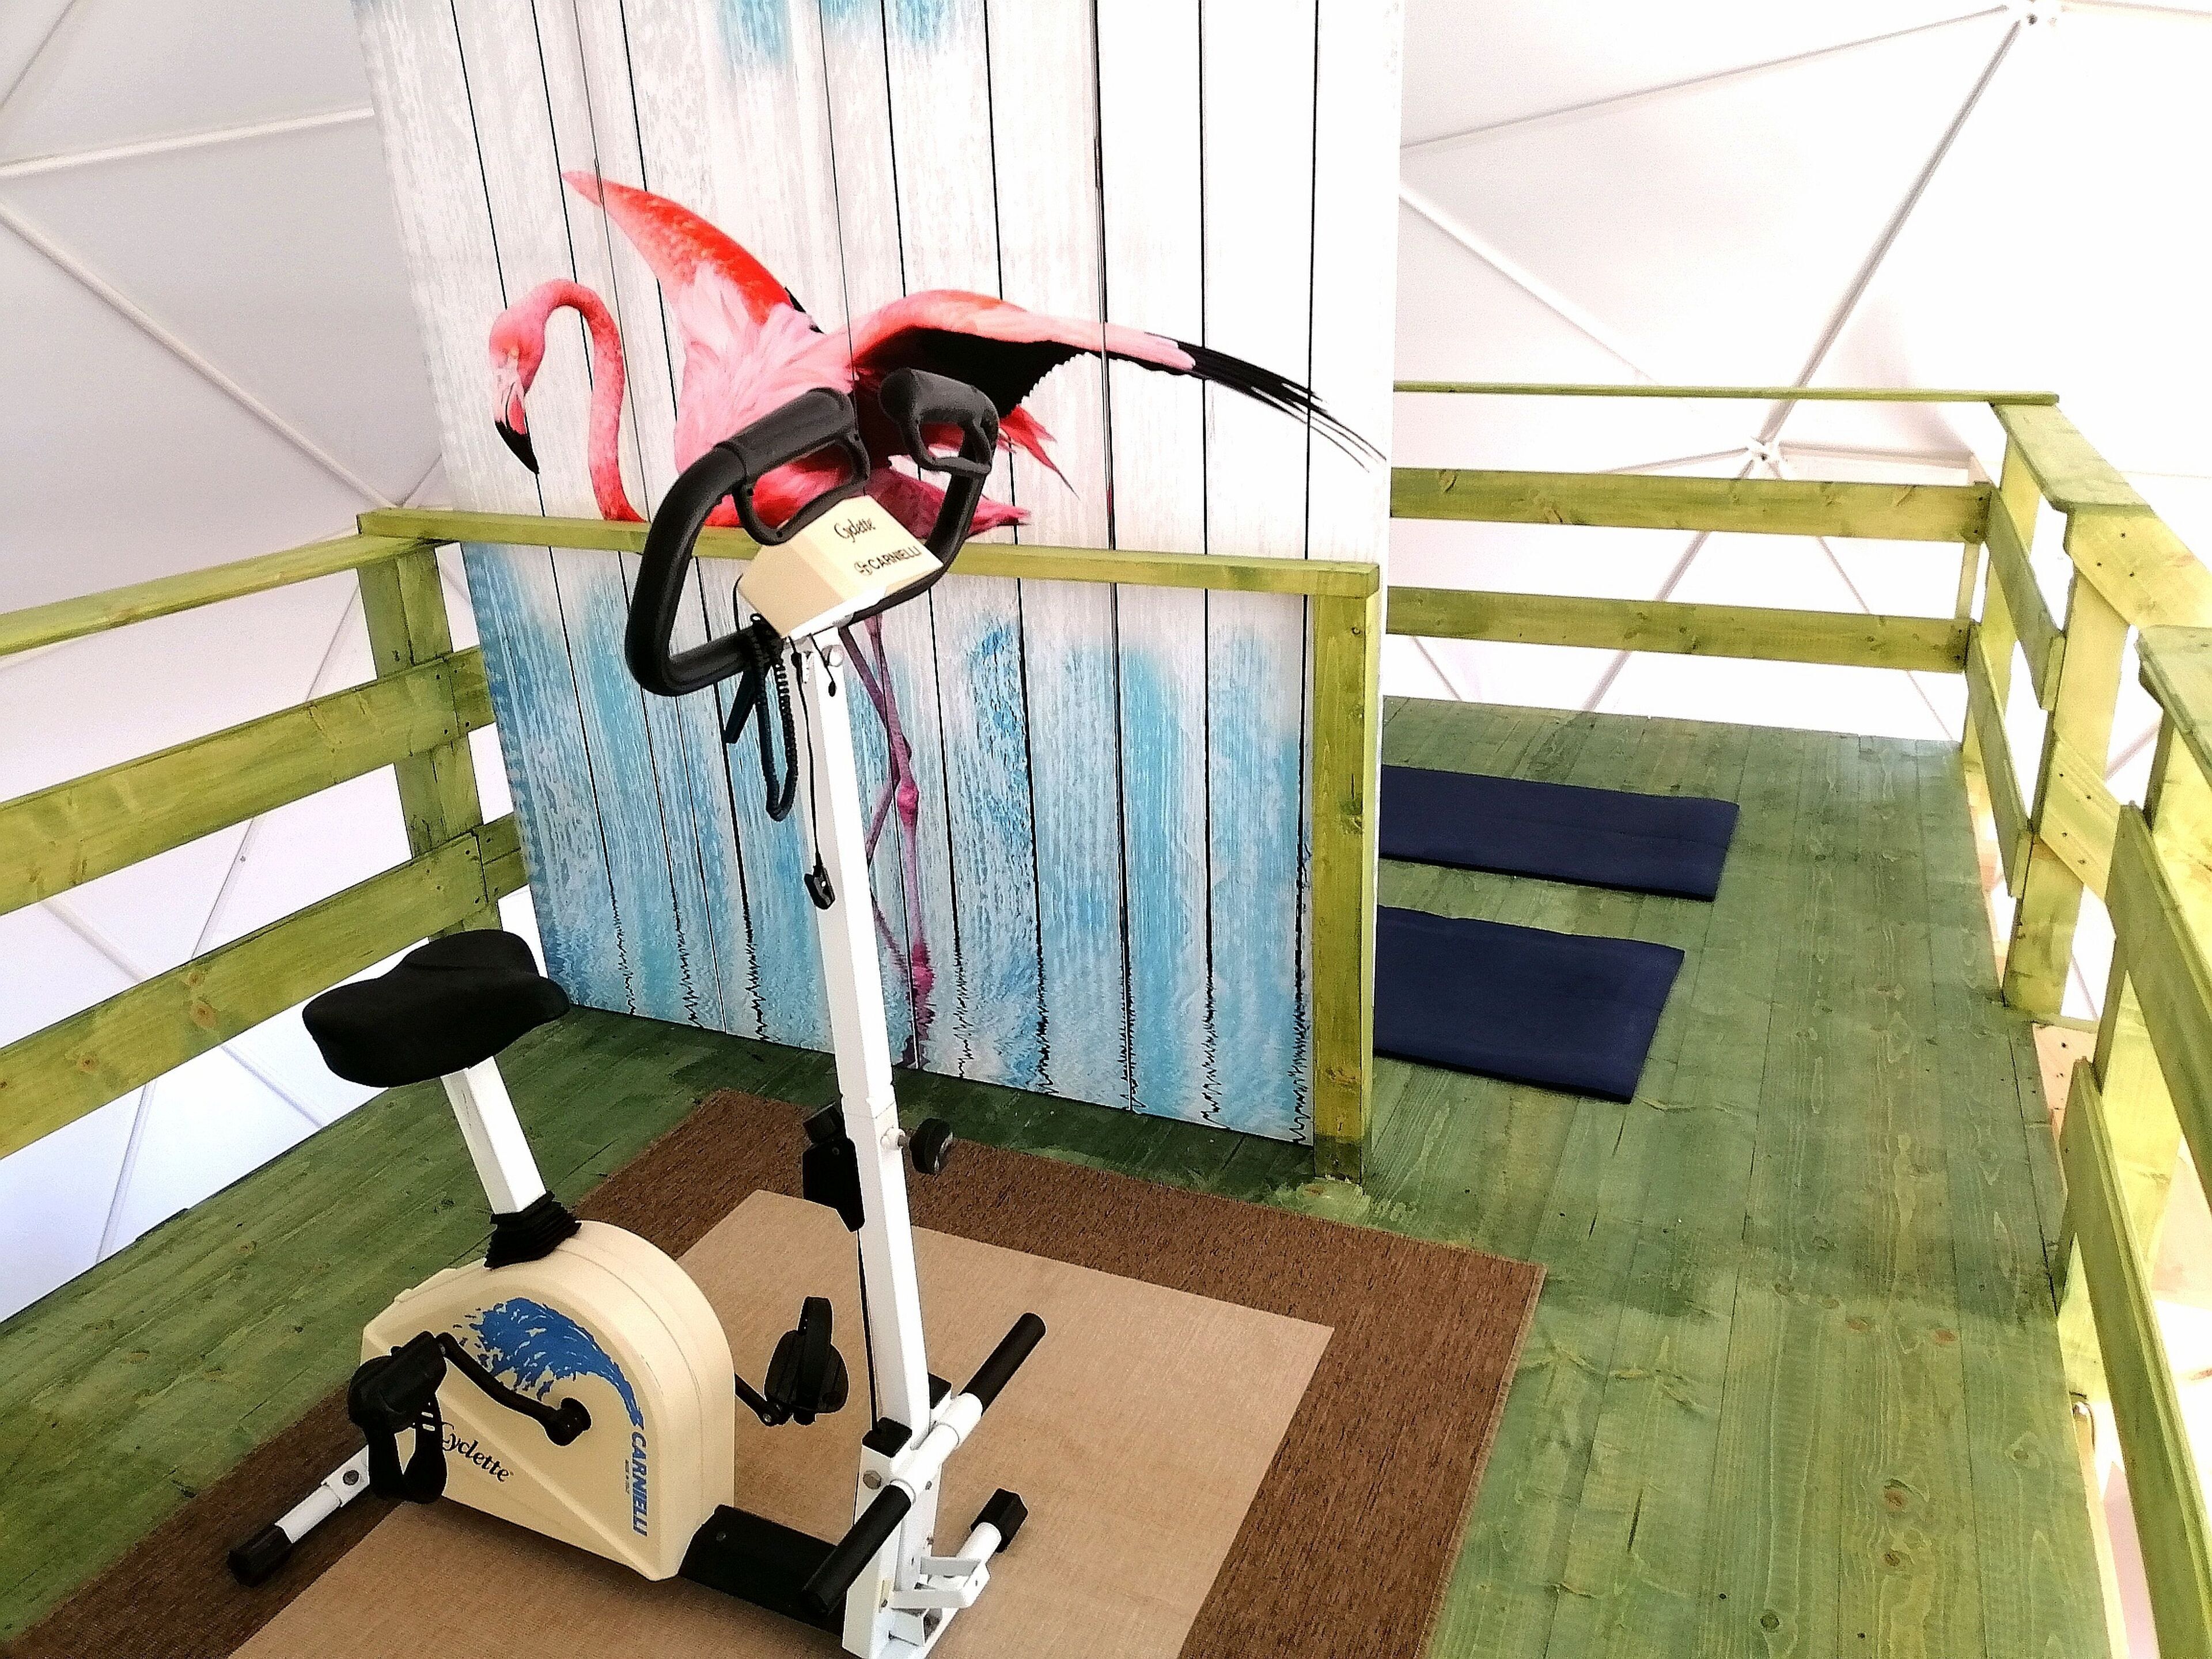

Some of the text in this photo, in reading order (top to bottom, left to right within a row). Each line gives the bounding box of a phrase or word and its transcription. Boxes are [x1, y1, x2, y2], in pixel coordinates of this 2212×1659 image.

[834, 518, 876, 543] Cyclette
[868, 546, 922, 569] CARNIELLI
[631, 1431, 648, 1537] CARNIELLI
